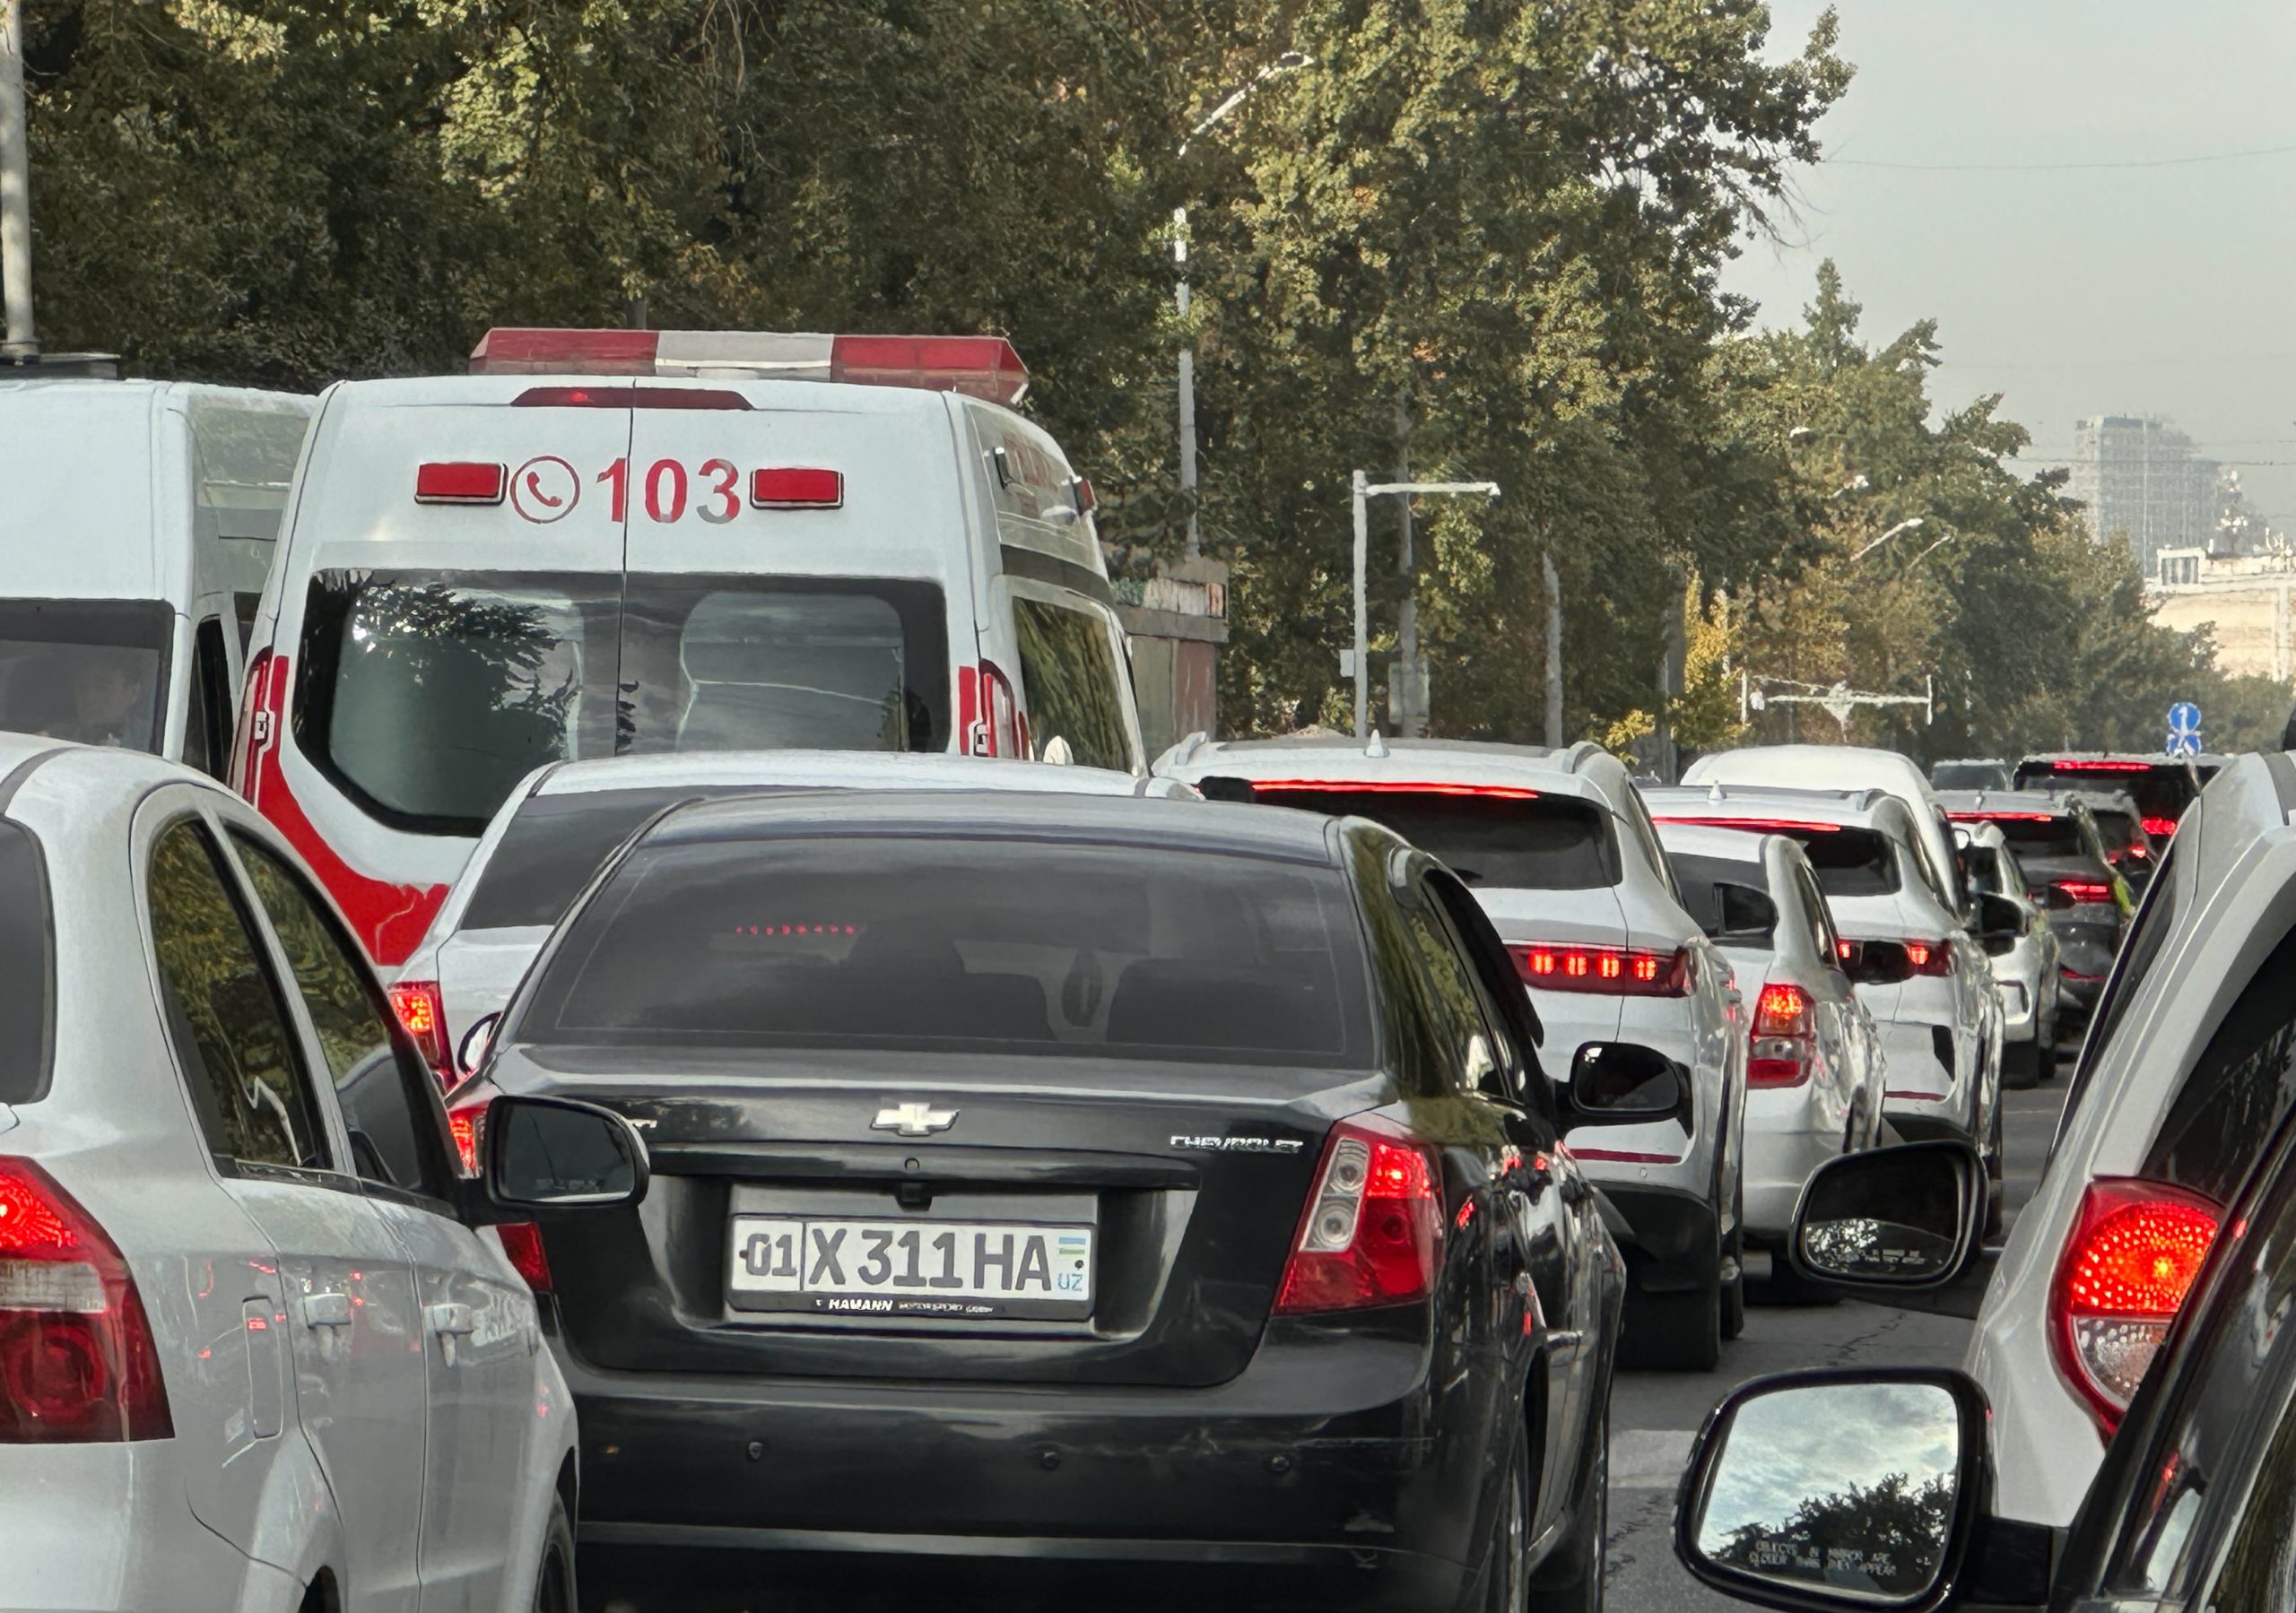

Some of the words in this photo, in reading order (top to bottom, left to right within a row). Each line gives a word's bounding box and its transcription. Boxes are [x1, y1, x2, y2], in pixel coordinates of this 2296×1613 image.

[596, 458, 741, 525] 103
[744, 1233, 797, 1278] 01
[1057, 1272, 1083, 1292] UZ
